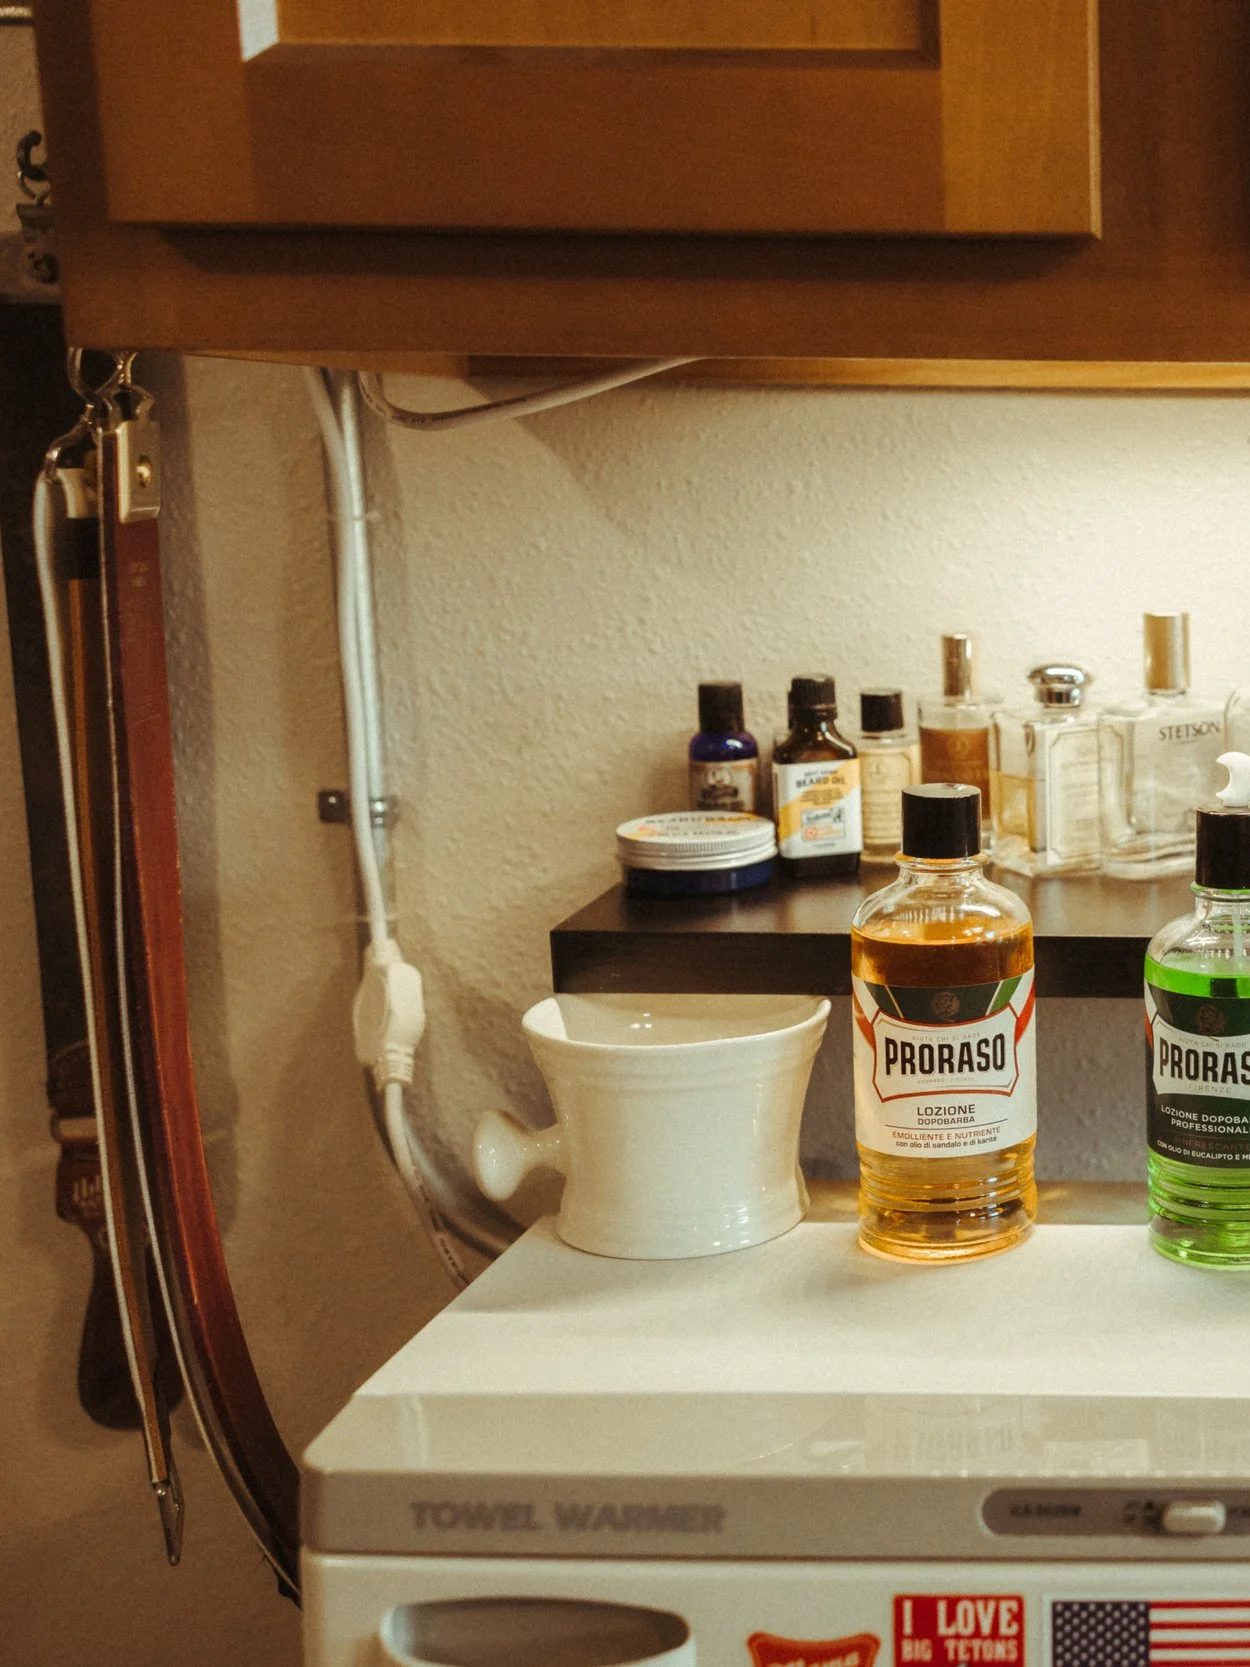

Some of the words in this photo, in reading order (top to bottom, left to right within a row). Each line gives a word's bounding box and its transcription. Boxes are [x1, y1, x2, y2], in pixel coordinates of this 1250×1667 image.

[1159, 719, 1220, 742] STETSON
[885, 1033, 1005, 1075] PRORASO
[1188, 1083, 1232, 1094] FIRENZE
[917, 1104, 976, 1116] LOZIONE
[1161, 1104, 1199, 1122] LOZIONE
[917, 1116, 976, 1126] DOPOBARBA
[892, 1131, 944, 1141] EMOLLIENTE
[955, 1126, 1001, 1140] NUTRIENTE
[910, 1140, 922, 1148] olio
[924, 1140, 931, 1149] di
[932, 1139, 962, 1149] sandalo
[969, 1137, 976, 1145] di
[1156, 1139, 1167, 1150] CON
[1168, 1144, 1182, 1154] OLIO
[1183, 1148, 1190, 1156] DI
[1191, 1150, 1233, 1161] EUCALIPTO
[1235, 1153, 1240, 1161] E
[411, 1500, 544, 1532] TOWEL
[554, 1502, 728, 1534] WARMER
[903, 1600, 912, 1636] I
[937, 1600, 1019, 1636] LOVE
[902, 1638, 932, 1662] BIG
[945, 1638, 1018, 1662] TETONS
